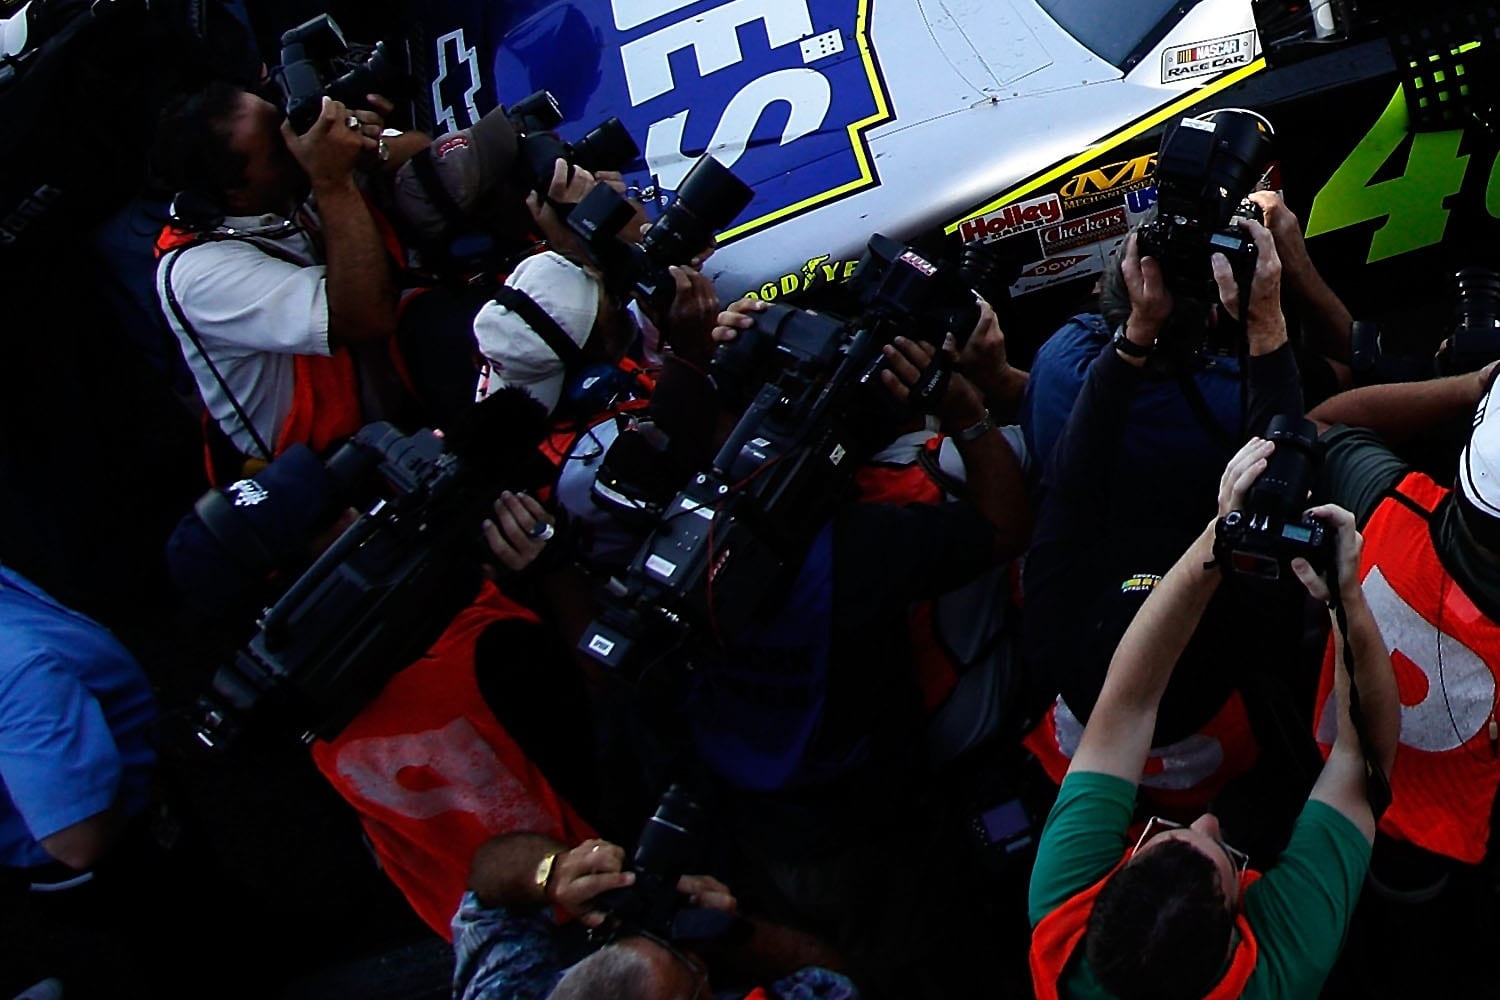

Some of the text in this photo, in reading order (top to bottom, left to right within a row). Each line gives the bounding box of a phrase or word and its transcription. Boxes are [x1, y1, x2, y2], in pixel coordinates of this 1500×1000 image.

[1195, 39, 1238, 61] NASCAR
[1168, 55, 1244, 77] RACE CAR
[1063, 187, 1129, 212] MECHANIX
[962, 198, 1061, 242] Holley
[1044, 211, 1121, 244] Checkers
[1034, 257, 1077, 276] DOW
